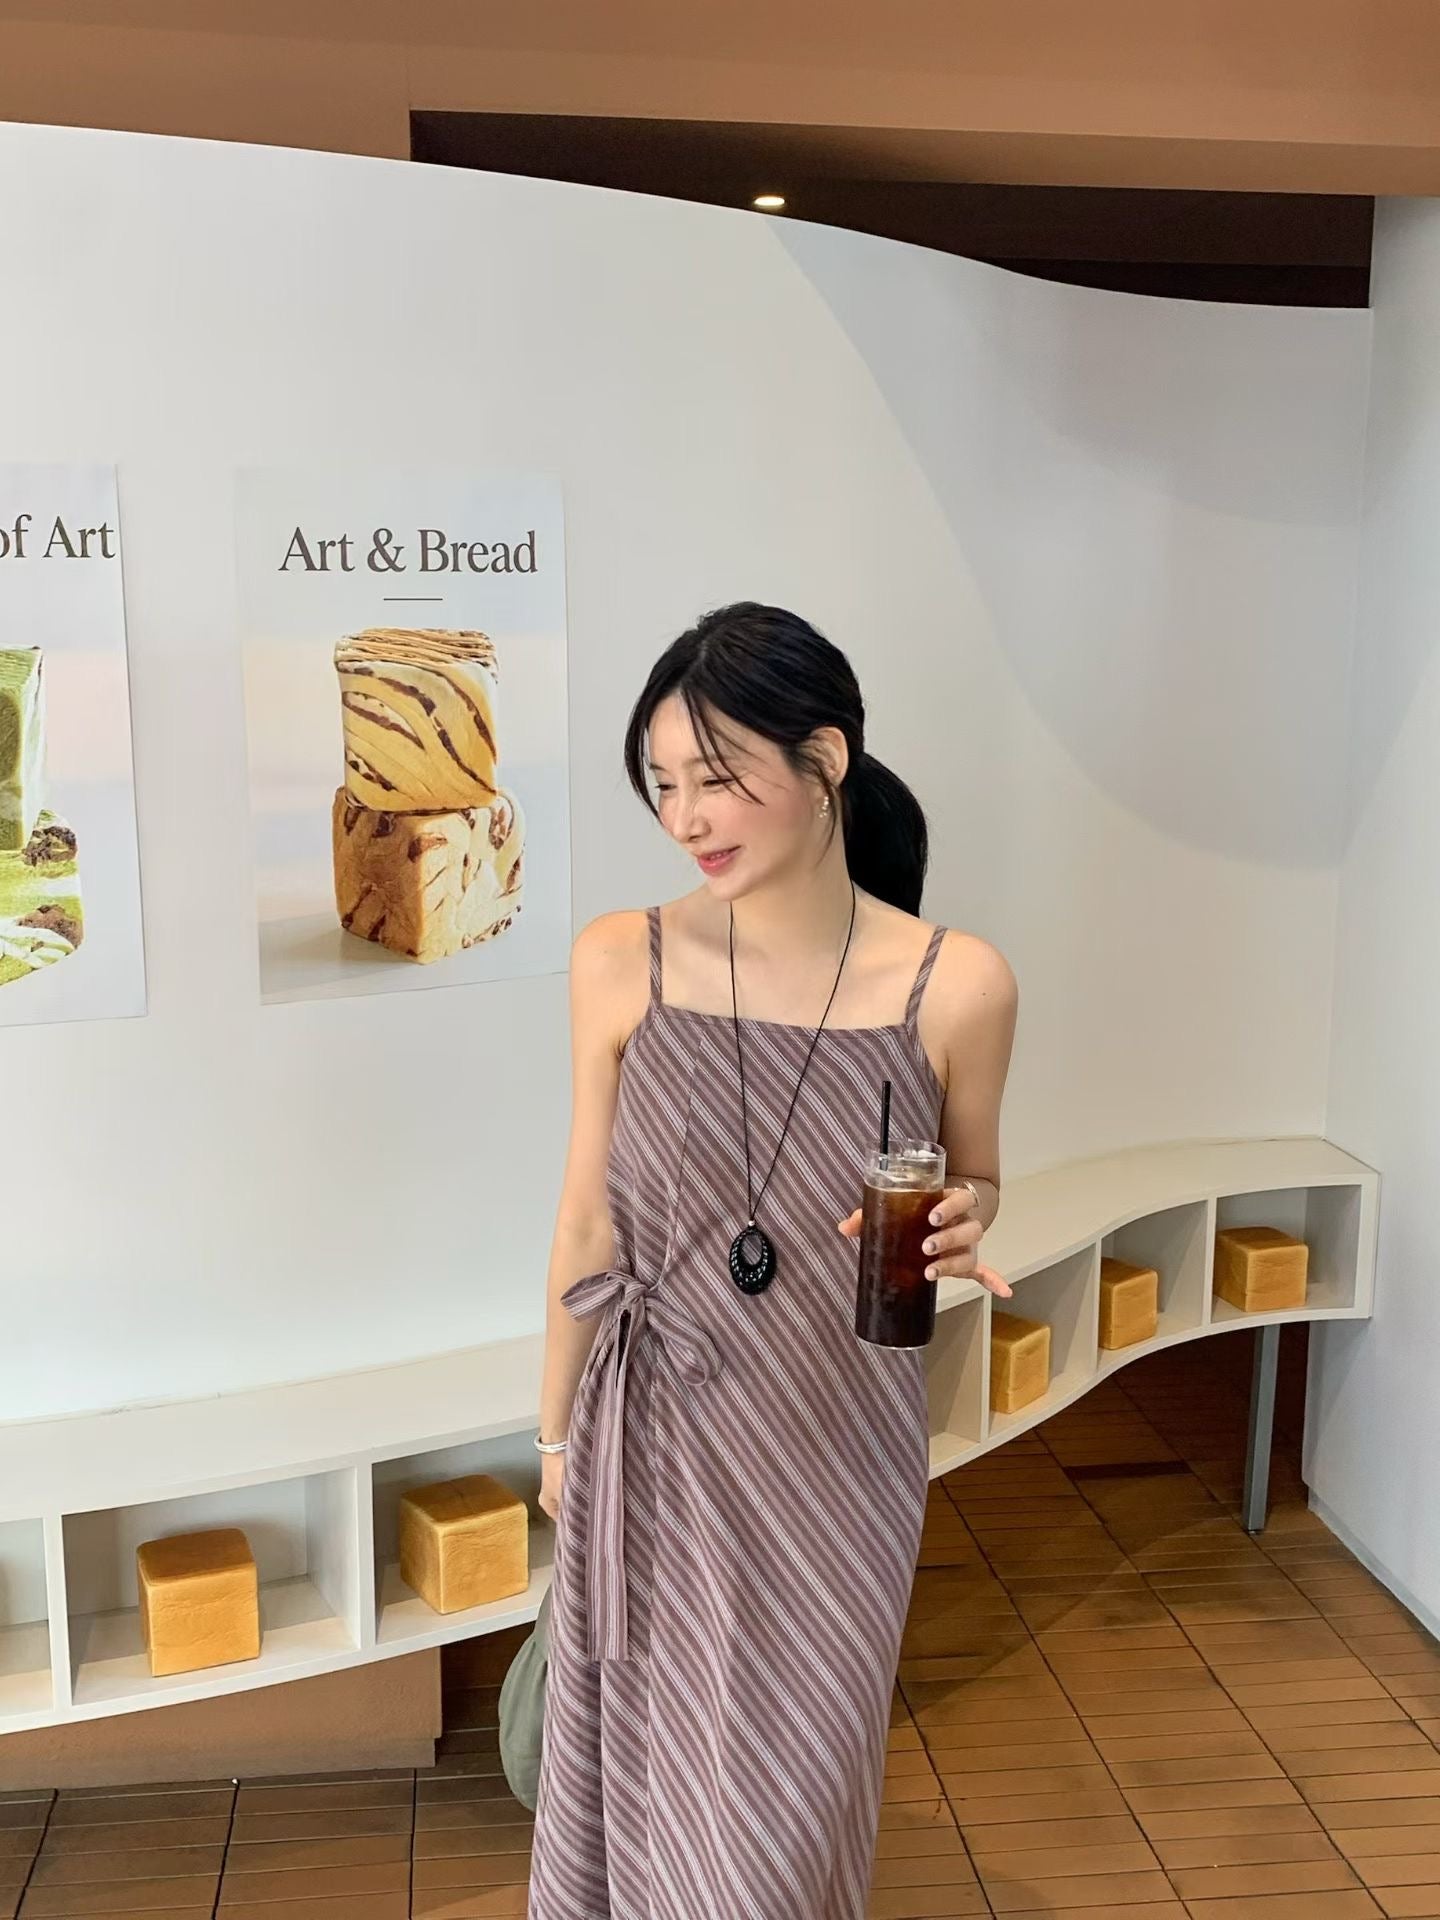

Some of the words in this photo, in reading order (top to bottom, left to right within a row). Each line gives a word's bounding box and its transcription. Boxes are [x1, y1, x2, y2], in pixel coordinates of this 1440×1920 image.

[42, 515, 116, 559] Art
[277, 526, 356, 572] Art
[366, 527, 407, 573] &
[417, 529, 539, 574] Bread
